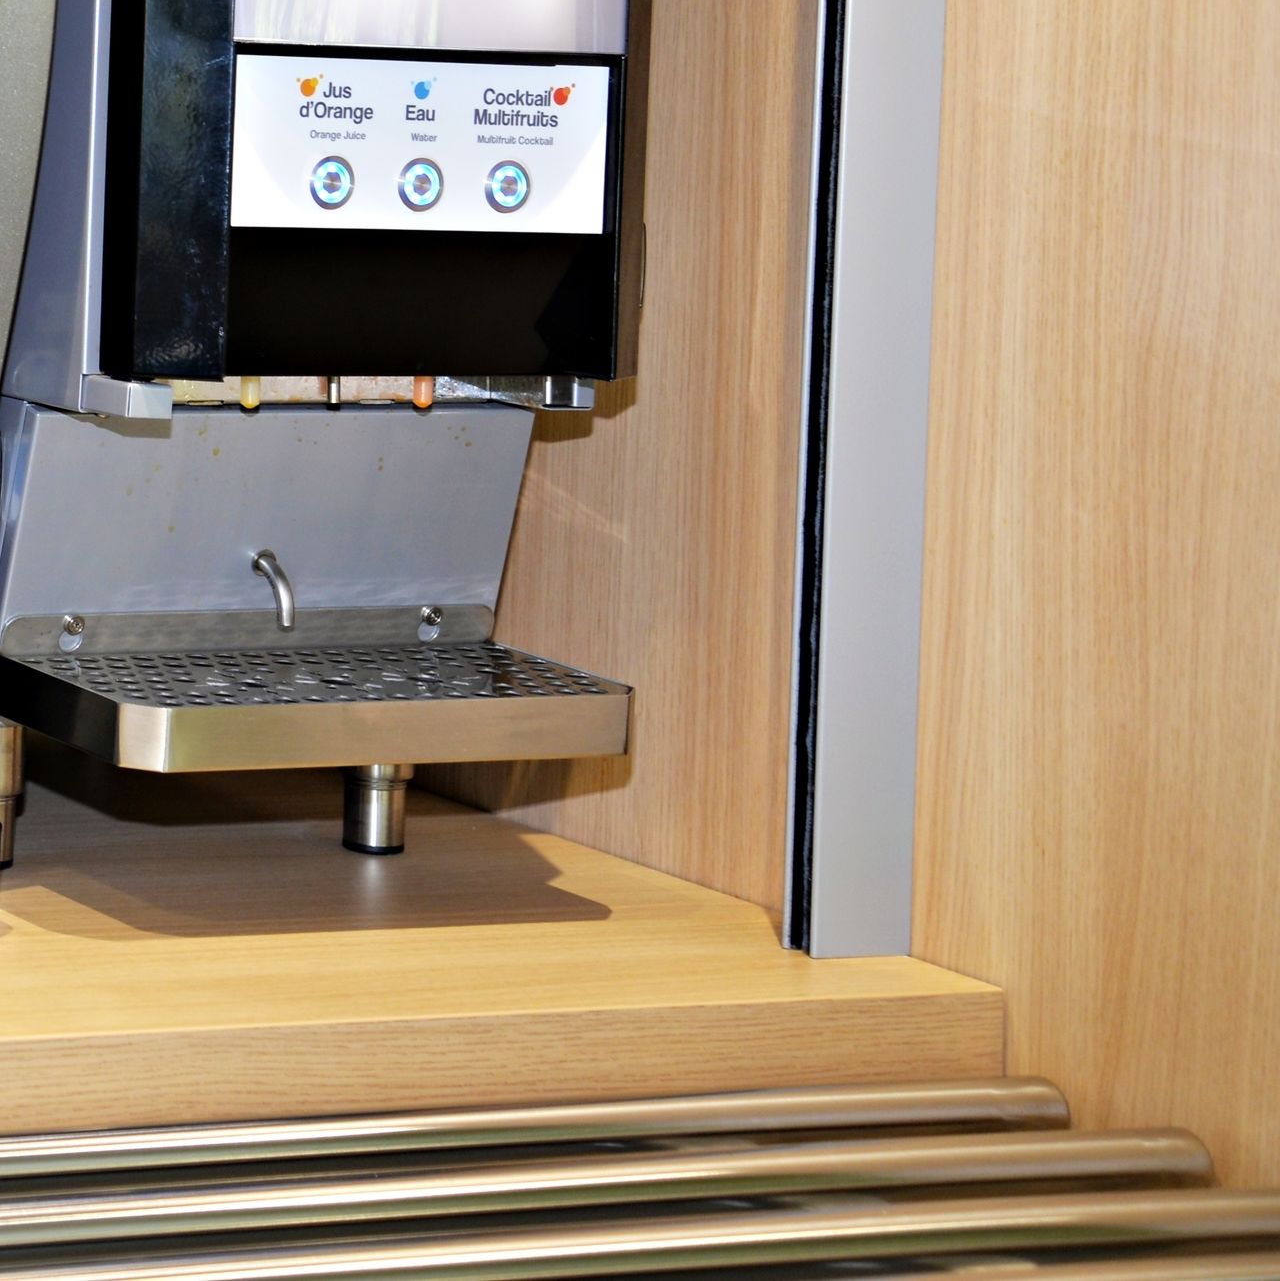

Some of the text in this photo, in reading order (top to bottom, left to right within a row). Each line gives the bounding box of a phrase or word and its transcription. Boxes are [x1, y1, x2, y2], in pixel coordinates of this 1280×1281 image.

[323, 82, 352, 98] Jus
[483, 88, 552, 107] Cocktail
[299, 101, 374, 124] d'Orange
[405, 104, 436, 121] Eau
[473, 108, 559, 128] Multifruits
[310, 129, 366, 142] Orange Juice
[411, 133, 437, 143] Water
[477, 134, 554, 146] Multifruit Cocktail
